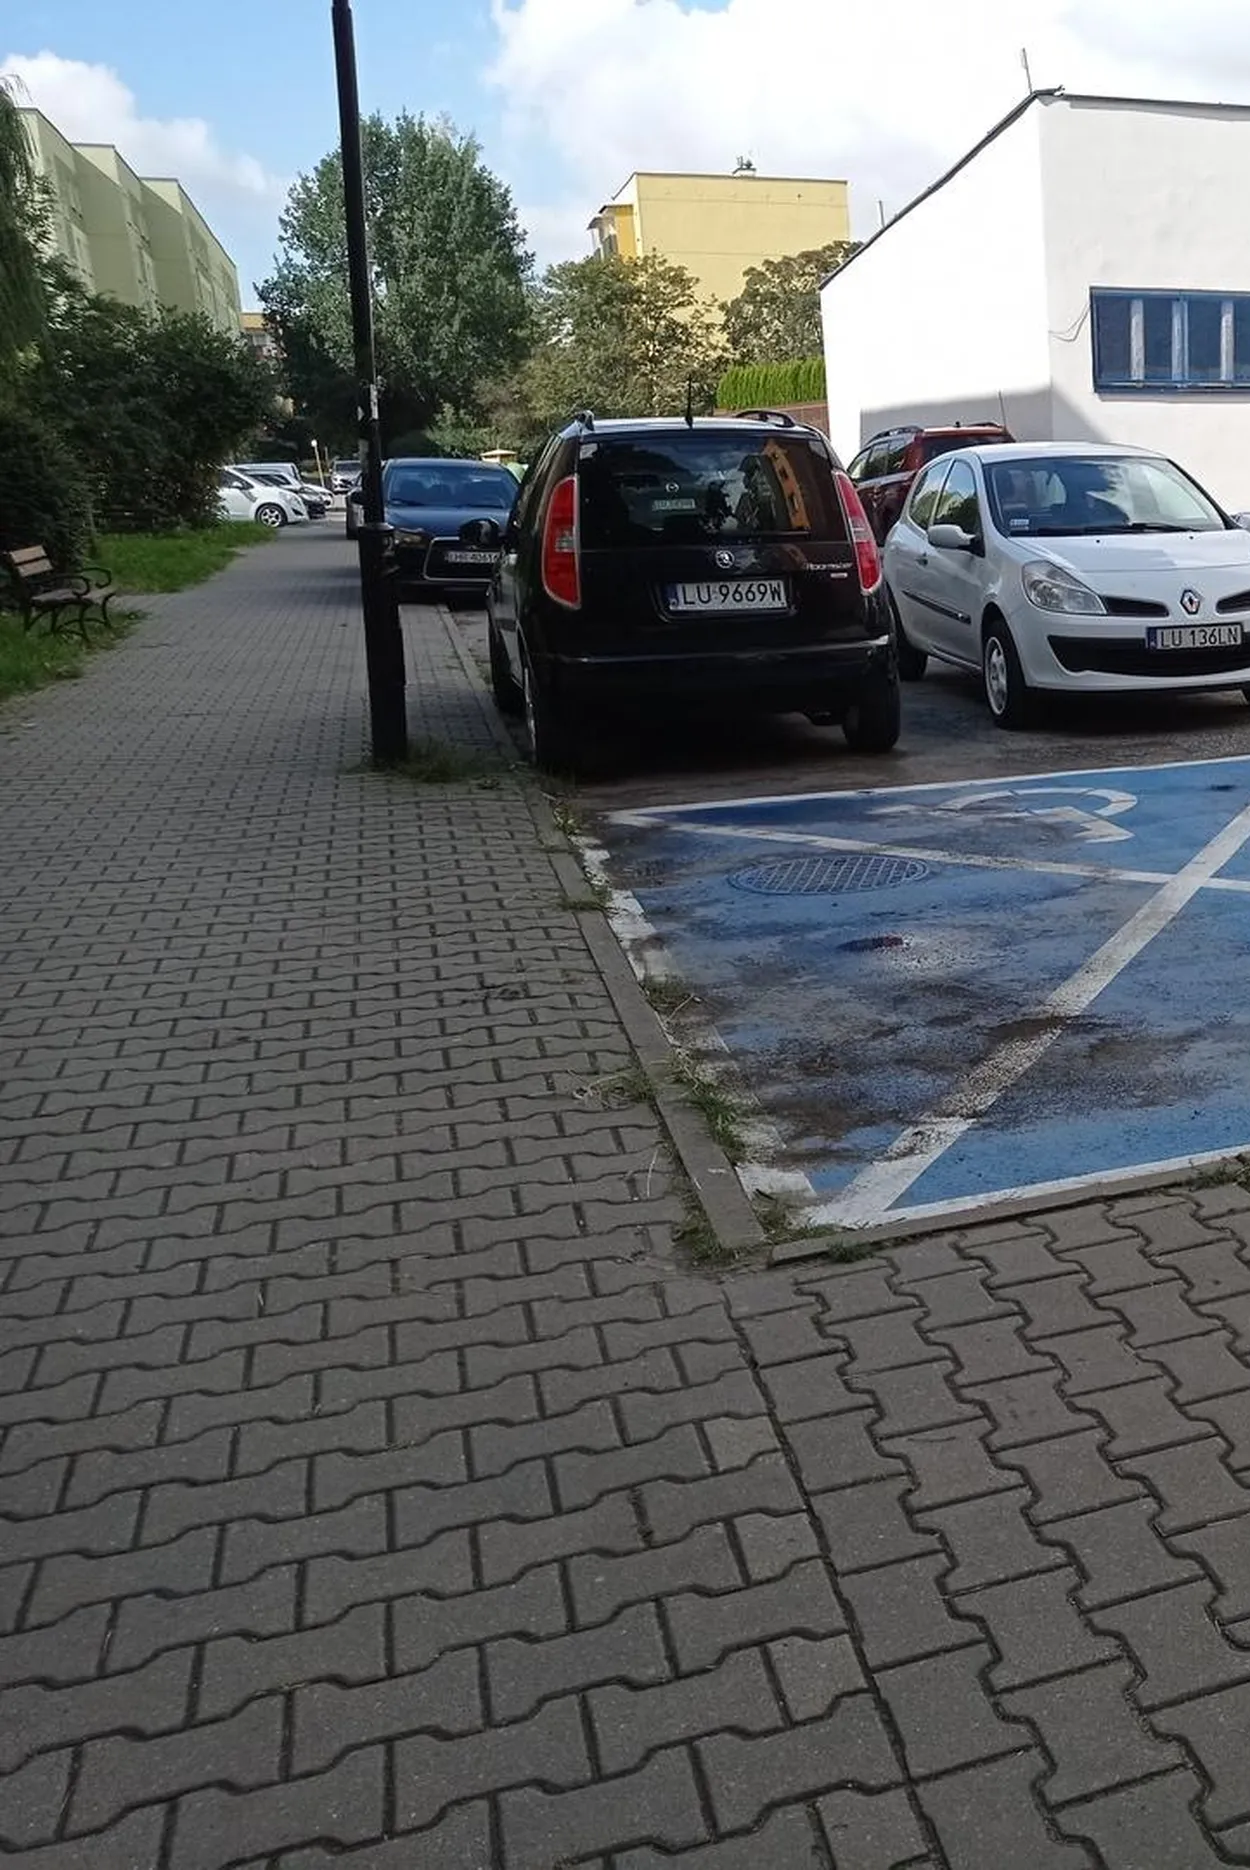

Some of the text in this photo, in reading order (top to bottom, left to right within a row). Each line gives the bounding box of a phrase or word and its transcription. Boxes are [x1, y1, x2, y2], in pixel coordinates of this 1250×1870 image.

[681, 583, 783, 605] LU 9669W
[1161, 626, 1239, 648] LU 136LN
